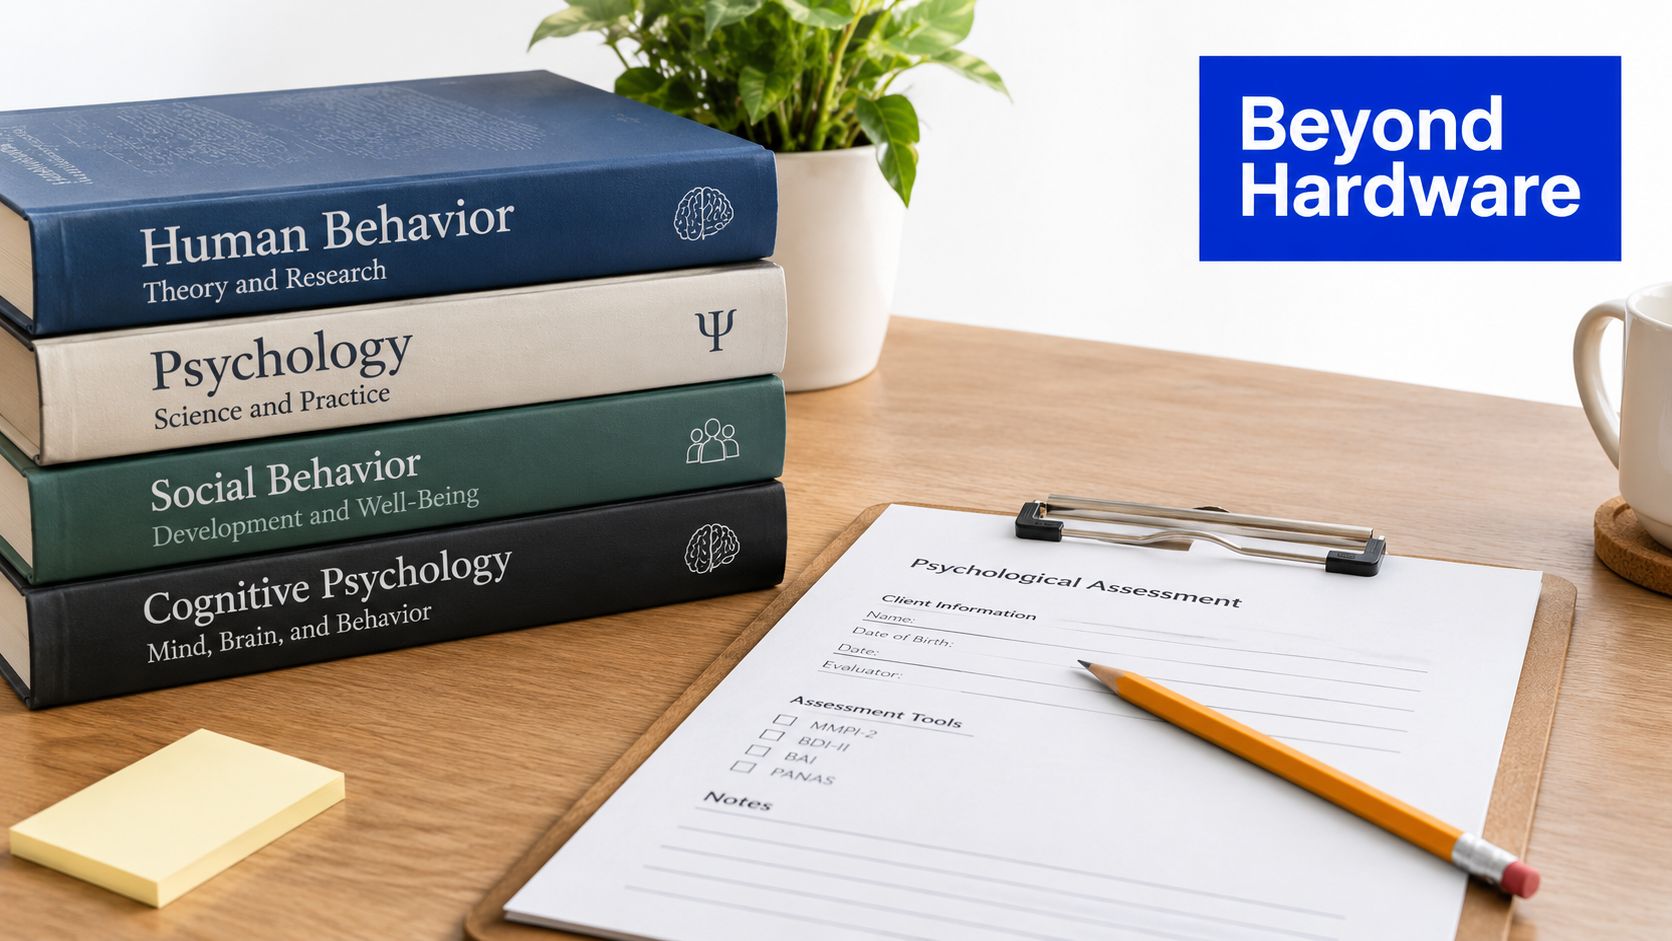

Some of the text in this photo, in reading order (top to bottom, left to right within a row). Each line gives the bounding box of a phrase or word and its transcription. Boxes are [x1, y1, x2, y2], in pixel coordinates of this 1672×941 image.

[140, 198, 515, 268] Human Behavior
[142, 258, 387, 304] Theory and Research
[151, 330, 413, 397] Psychology
[154, 384, 391, 430] Science and Practice
[151, 450, 420, 512] Social Behavior
[152, 484, 480, 547] Development and Well-Being
[143, 548, 513, 627] Cognitive Psychology
[909, 557, 1243, 609] Psychological Assessment
[866, 610, 917, 624] Name:
[881, 595, 1037, 621] Client Information
[147, 601, 432, 663] Mind, Brain, and Behavior
[852, 626, 955, 648] Date of Birth:
[838, 643, 879, 657] Date:
[822, 660, 902, 679] Evaluator:
[790, 695, 963, 729] Assessment Tools
[798, 736, 850, 753] BDI-II
[810, 720, 878, 740] MMPI-2
[784, 751, 817, 765] BAI
[770, 767, 836, 786] PANAS
[703, 790, 773, 811] Notes
